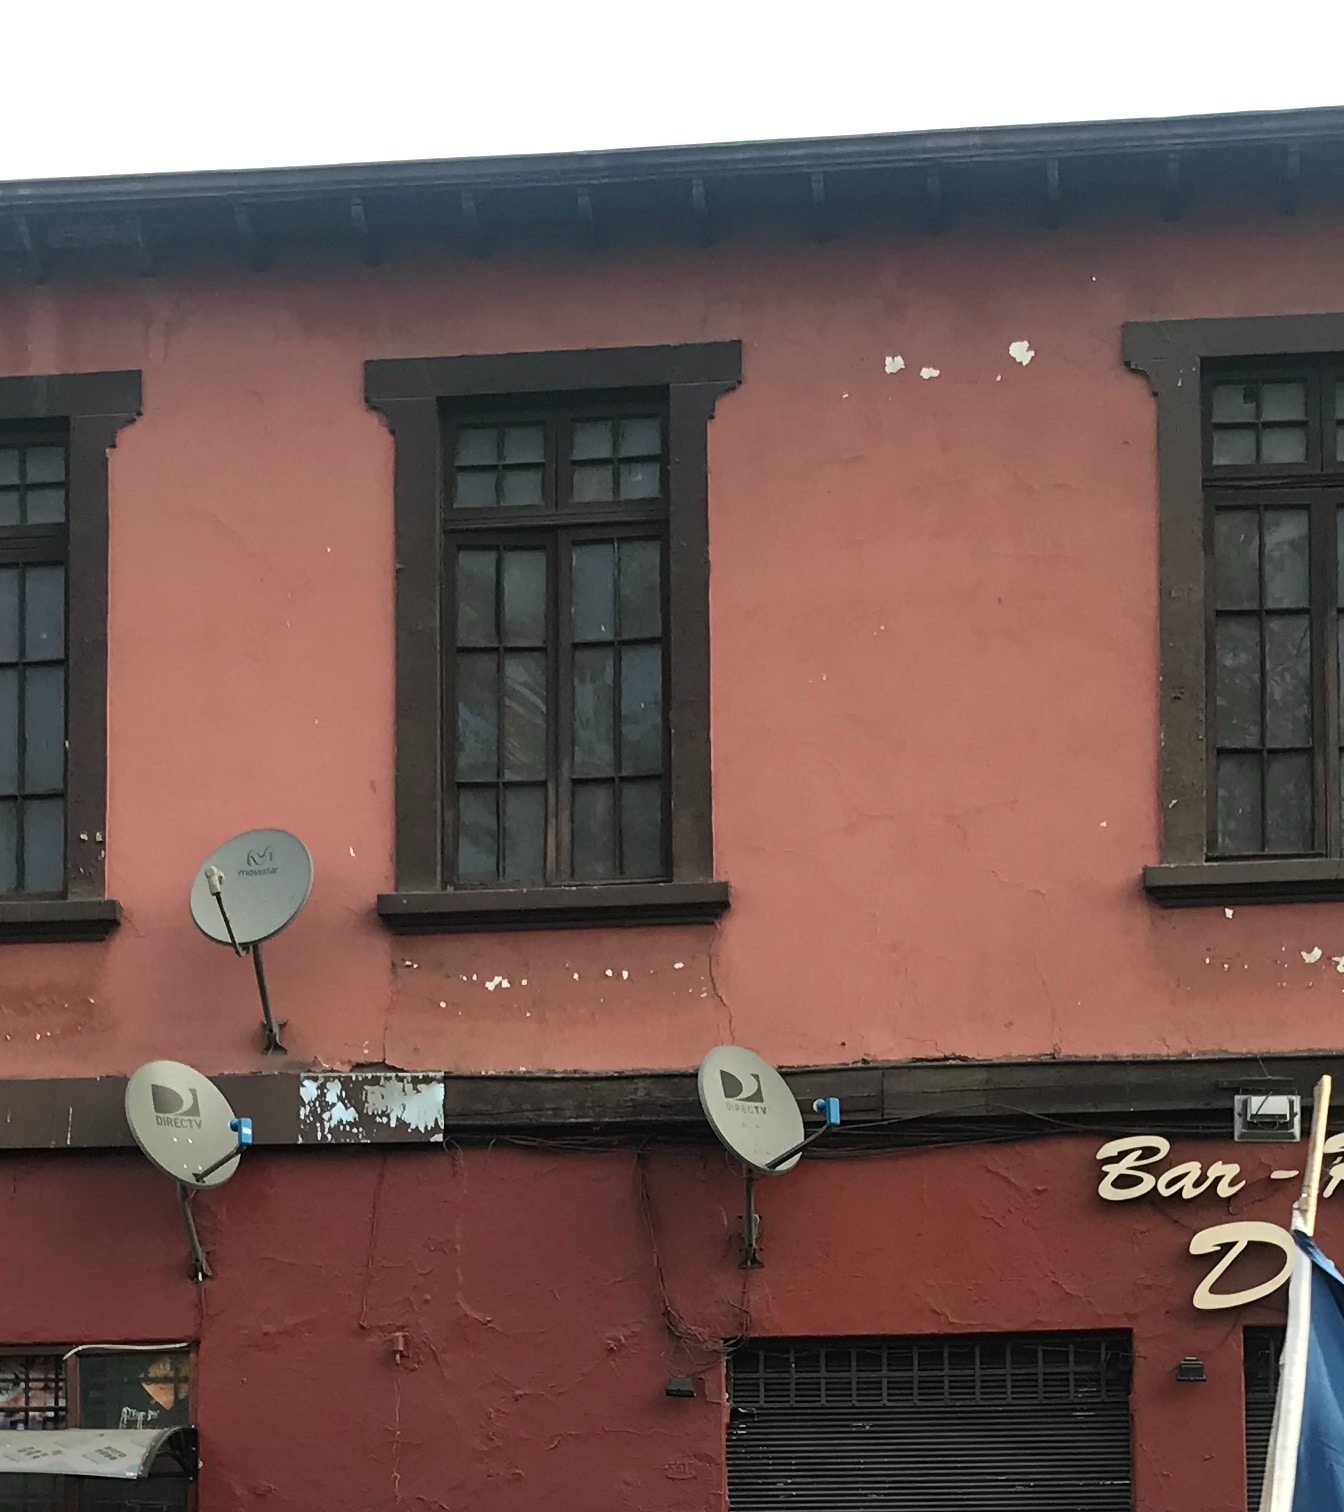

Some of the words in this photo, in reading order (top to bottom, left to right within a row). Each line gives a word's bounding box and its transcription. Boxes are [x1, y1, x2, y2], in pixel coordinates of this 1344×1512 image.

[726, 1102, 767, 1115] DIRECTV
[156, 1115, 203, 1130] DIRECTV
[1095, 1135, 1245, 1201] Bar
